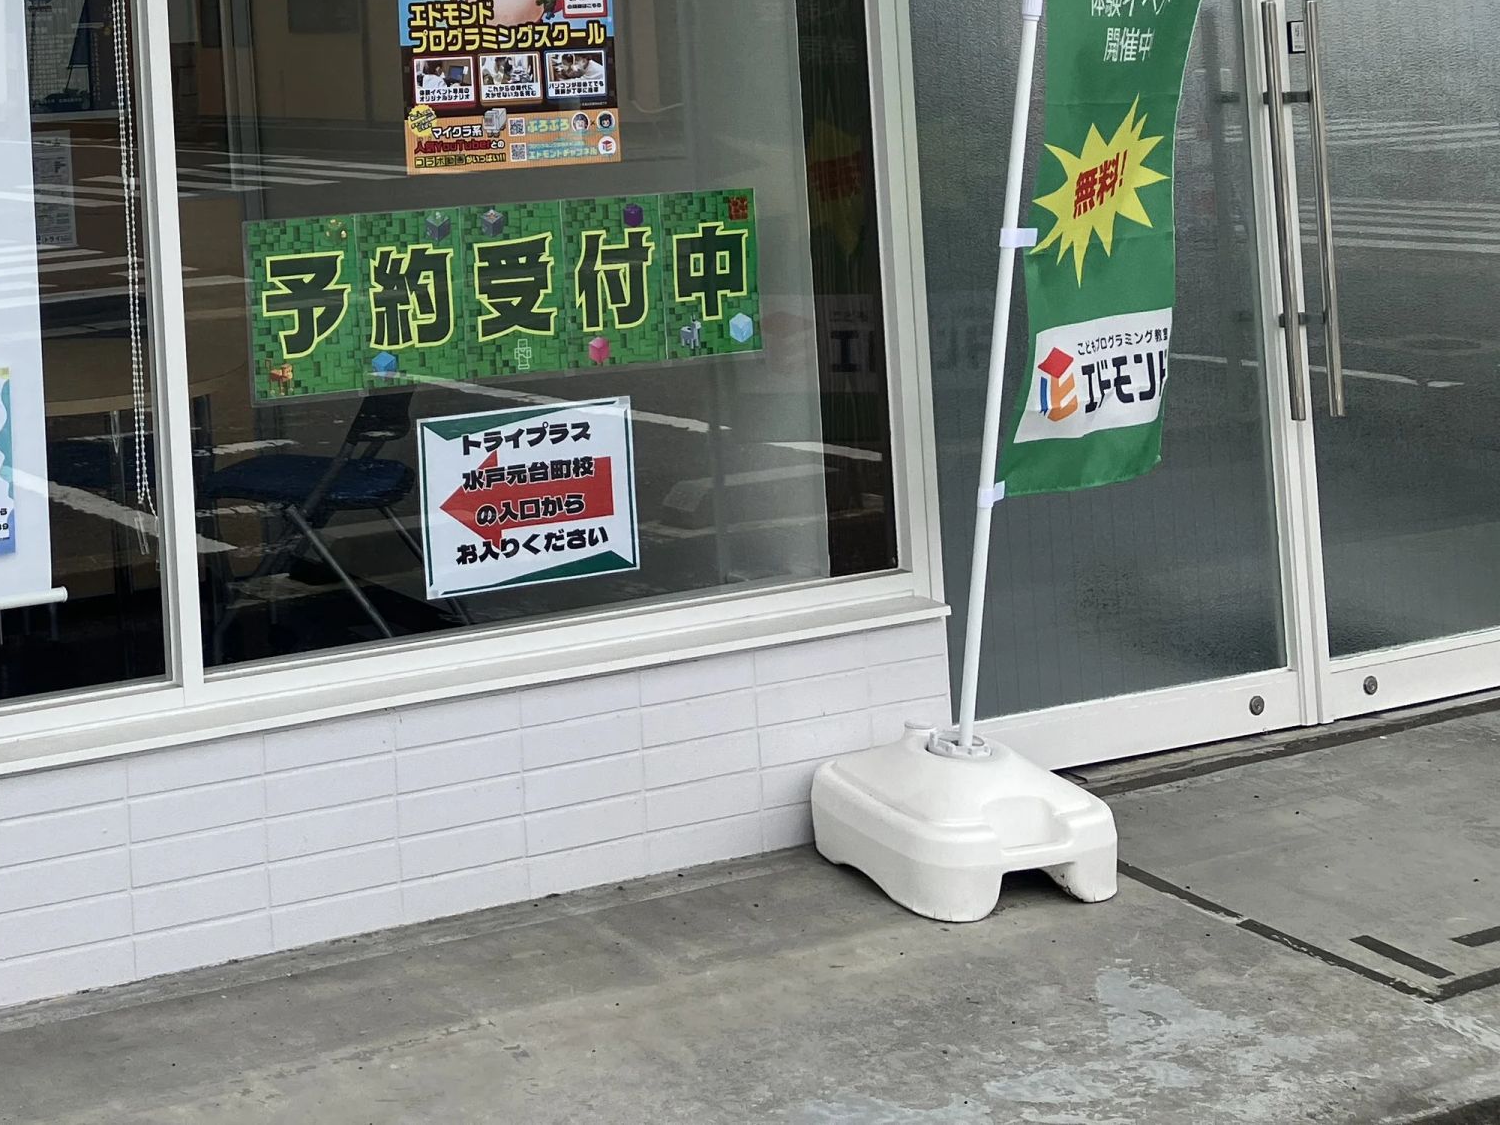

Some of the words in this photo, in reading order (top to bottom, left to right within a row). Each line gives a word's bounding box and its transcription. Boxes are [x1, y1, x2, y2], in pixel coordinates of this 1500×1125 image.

[410, 1, 493, 27] エドモンド
[411, 22, 606, 53] プログラミングスクール
[431, 125, 483, 139] マイクラ系
[1073, 149, 1127, 219] 無料!
[261, 221, 749, 359] 予約受付中
[461, 420, 591, 455] トライプラス
[461, 455, 595, 492] 水戸元台町校
[475, 493, 586, 526] の入口から
[455, 526, 610, 566] お入りください
